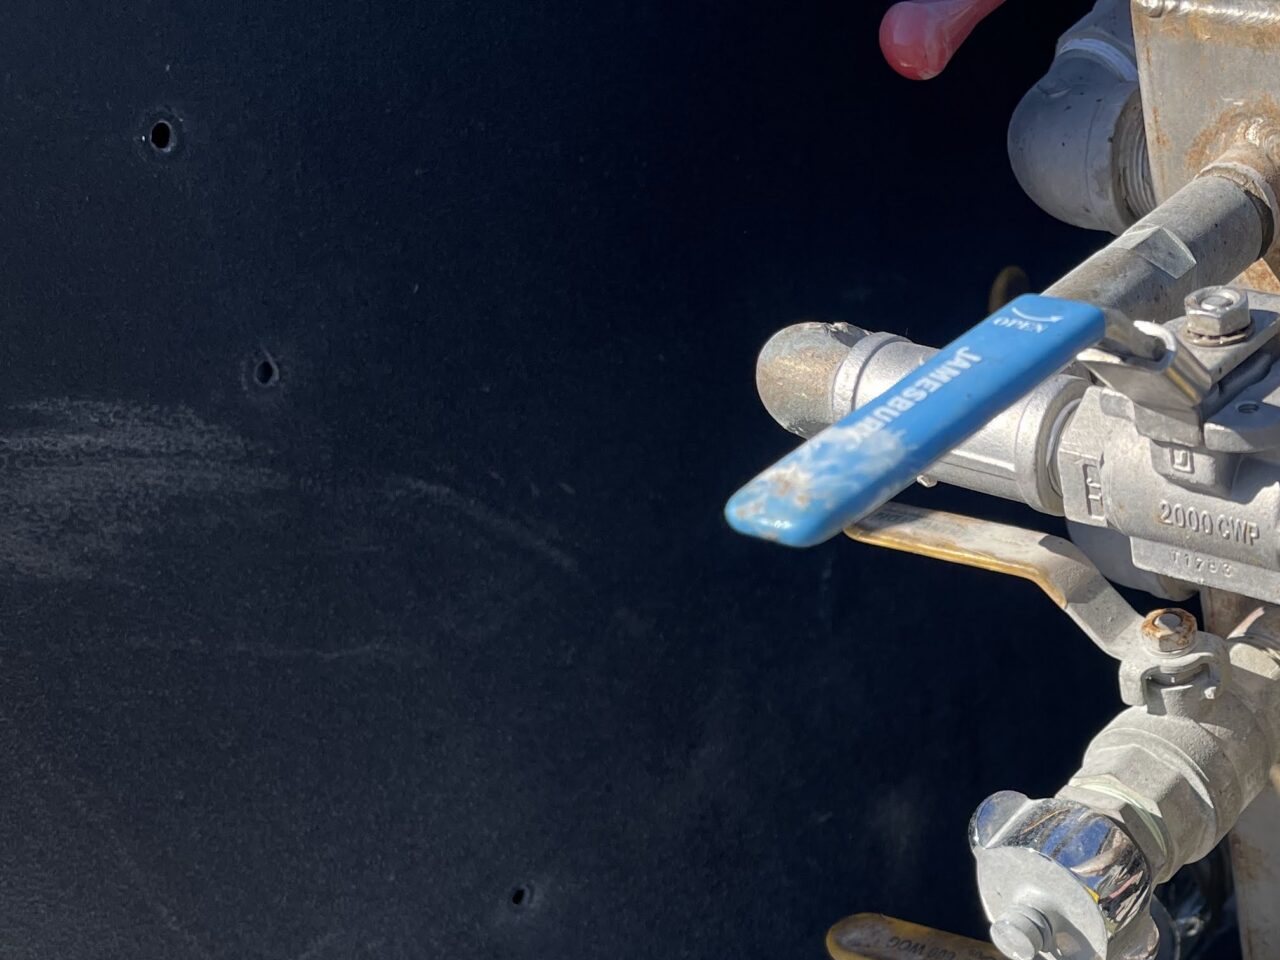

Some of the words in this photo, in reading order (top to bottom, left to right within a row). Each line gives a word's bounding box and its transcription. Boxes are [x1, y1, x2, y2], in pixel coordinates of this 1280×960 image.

[993, 315, 1048, 334] OPEN
[1157, 498, 1214, 536] 2000
[1217, 513, 1261, 547] CWP
